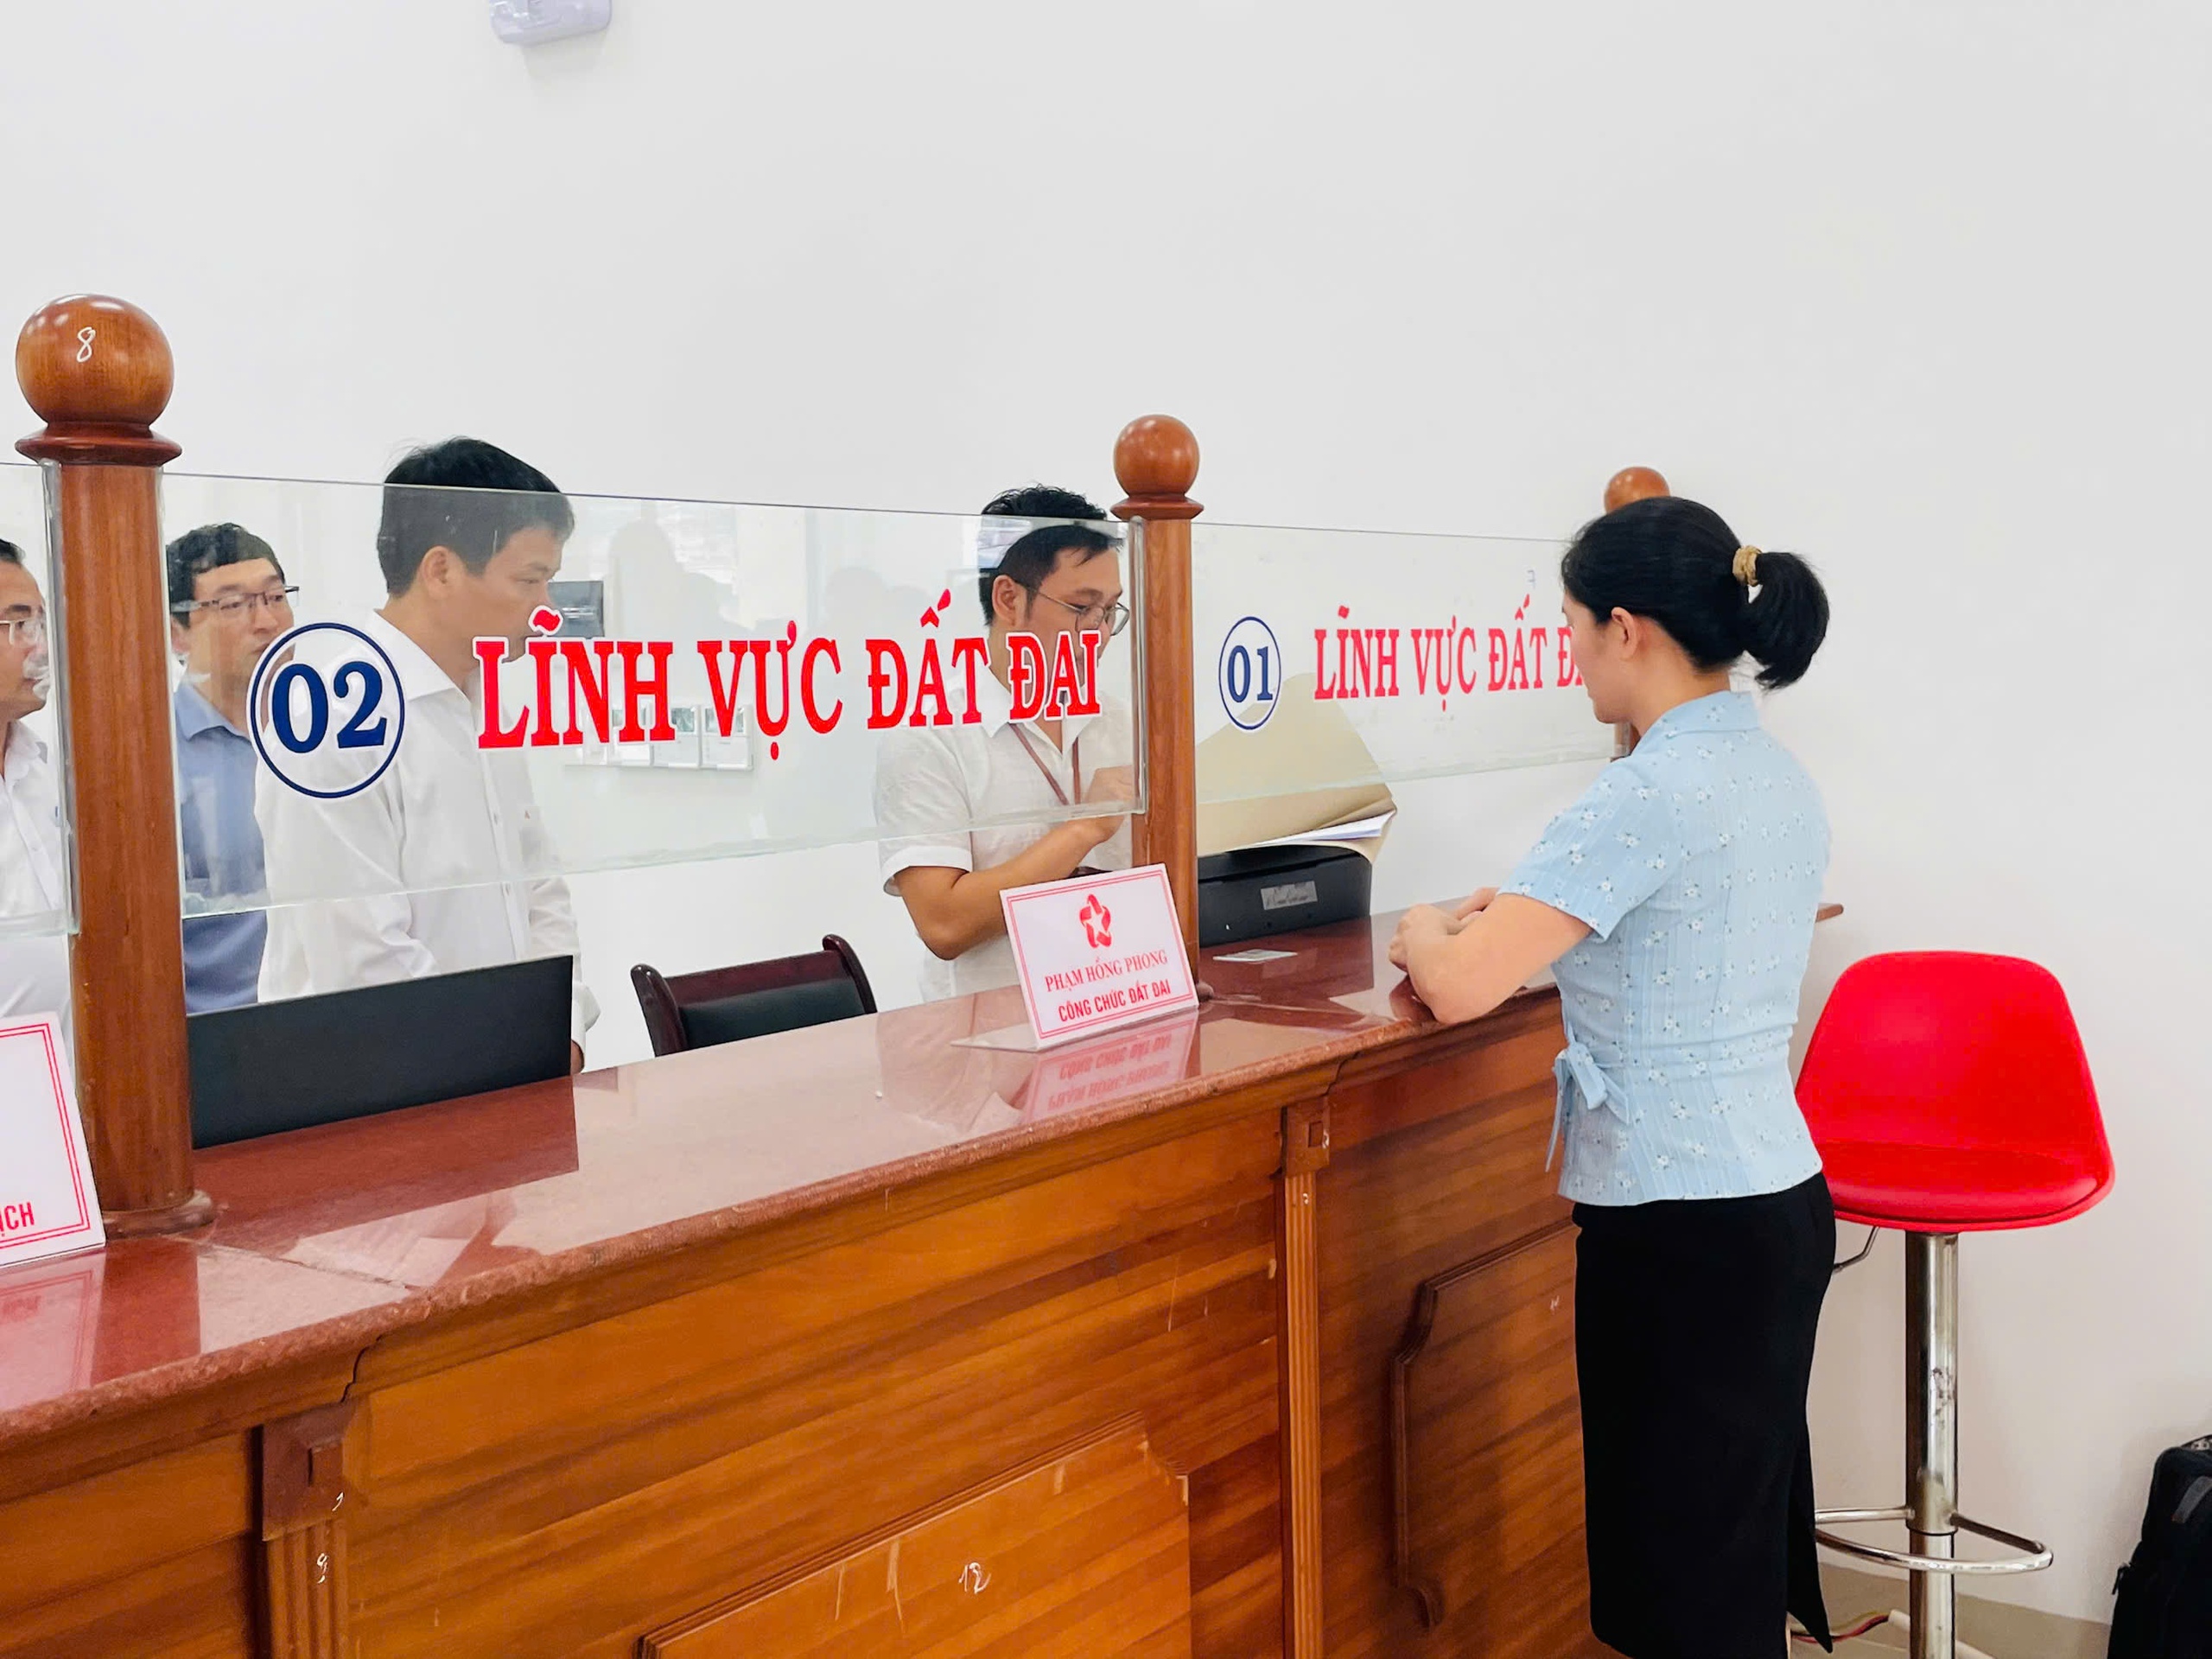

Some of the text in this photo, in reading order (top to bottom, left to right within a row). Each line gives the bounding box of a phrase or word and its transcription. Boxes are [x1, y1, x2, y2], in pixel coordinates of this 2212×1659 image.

[76, 326, 97, 363] 8
[475, 588, 1102, 760] LĨNH VỰC ĐẤT ĐAI
[1227, 645, 1274, 703] 01
[1410, 614, 1477, 712] VỰC
[1488, 593, 1548, 692] ĐẤT
[271, 660, 388, 754] 02
[1044, 949, 1168, 993] PHẠM HỒNG PHONG
[1058, 978, 1172, 1022] CÔNG CHỨC ĐẤT ĐAI
